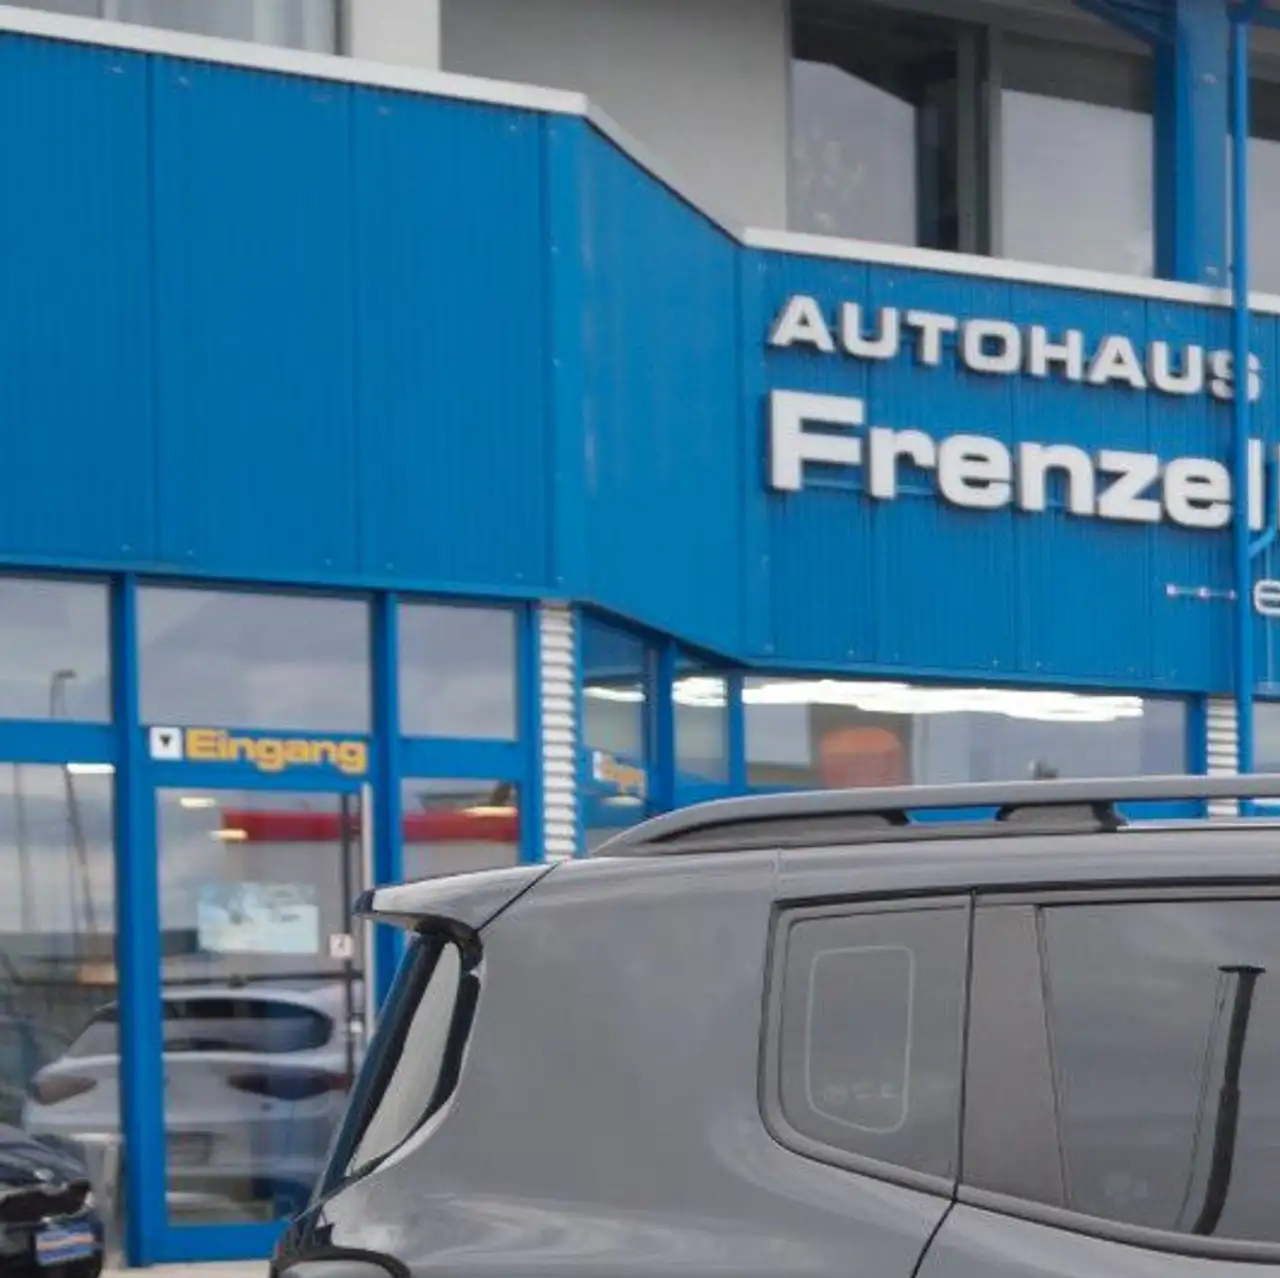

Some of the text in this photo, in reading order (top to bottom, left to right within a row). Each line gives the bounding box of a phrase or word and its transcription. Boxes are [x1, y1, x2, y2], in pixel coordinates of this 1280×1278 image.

[767, 295, 1261, 401] AUTOHAUS
[768, 389, 1264, 530] Frenzel
[185, 727, 368, 774] Eingang
